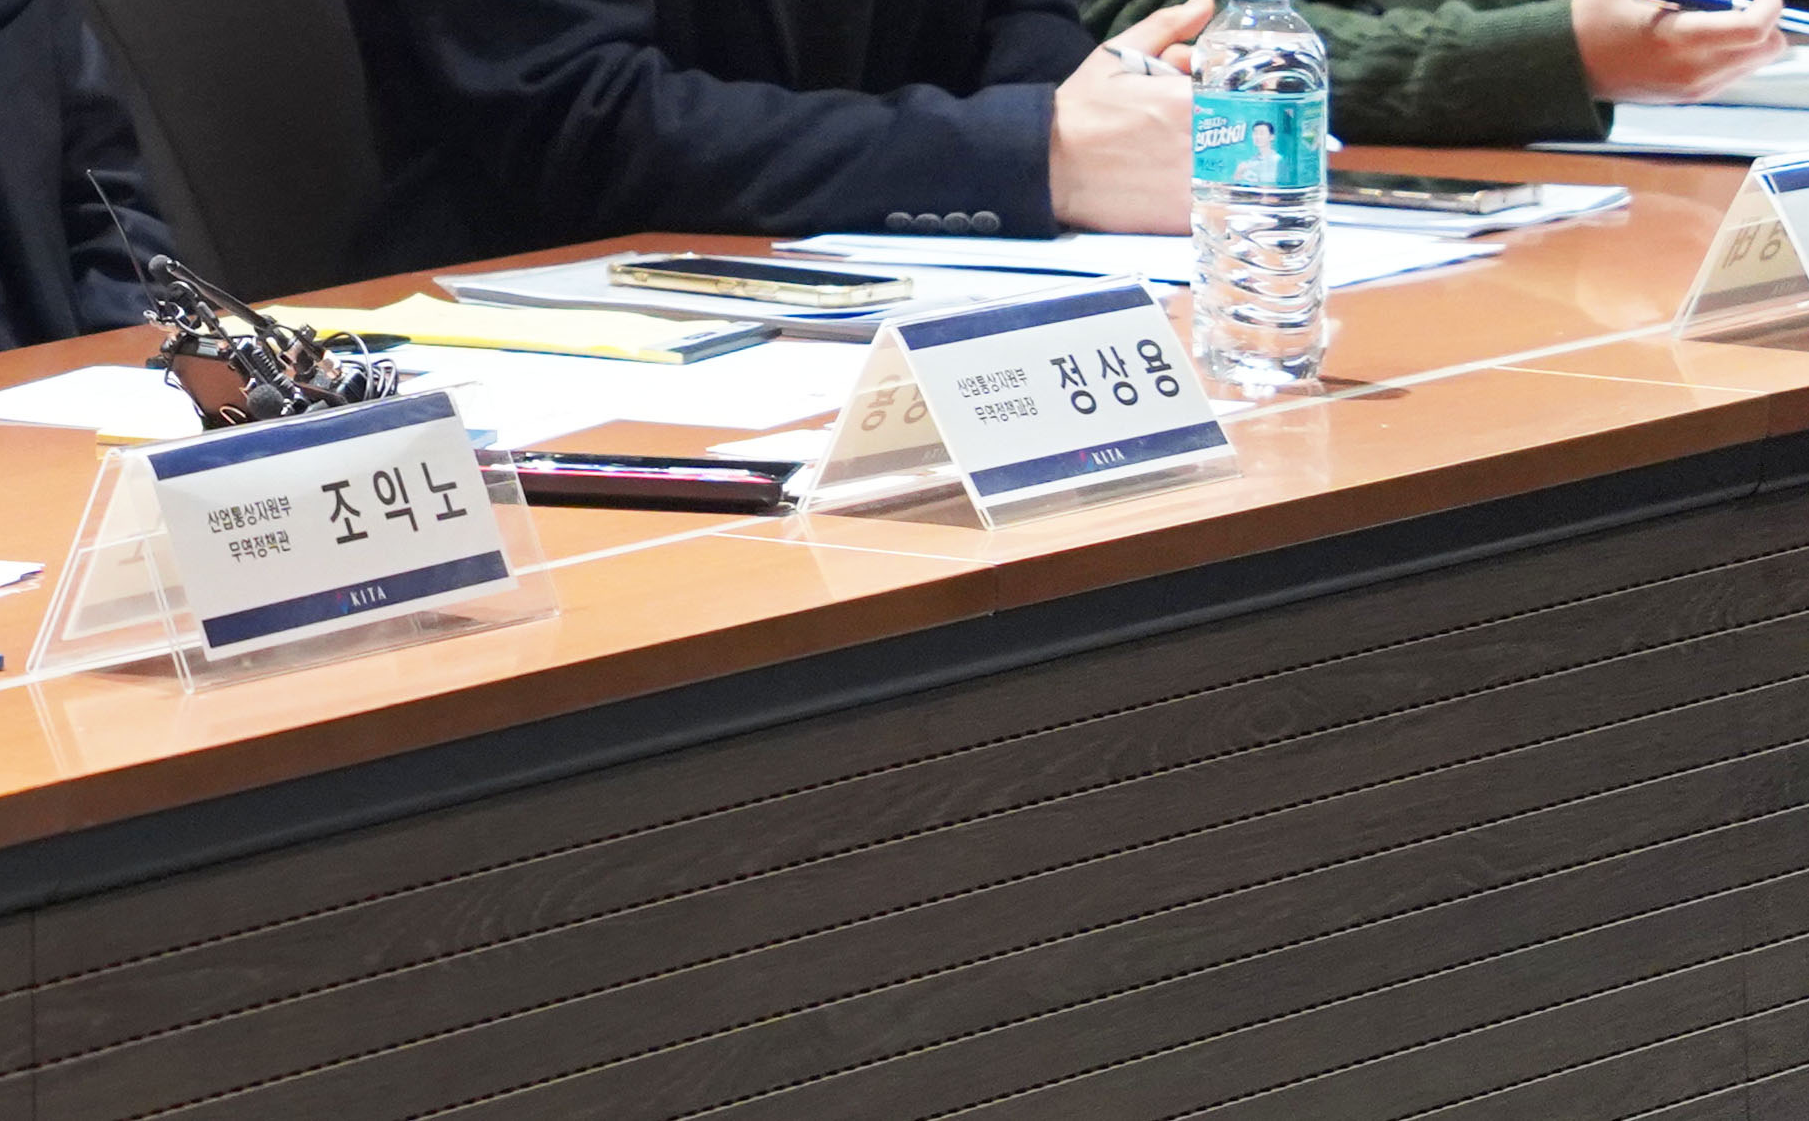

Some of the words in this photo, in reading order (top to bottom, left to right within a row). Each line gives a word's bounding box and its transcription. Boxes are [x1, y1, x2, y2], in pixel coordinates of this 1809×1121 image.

[956, 367, 1027, 398] 산업통상자원부
[1049, 338, 1180, 415] 정상용
[974, 396, 1038, 425] 무역정책과장
[1091, 447, 1125, 465] KITA
[207, 495, 292, 533] 산업통상자원부
[320, 461, 468, 545] 조익노
[228, 529, 291, 563] 무역정책관
[349, 585, 387, 607] KITA
